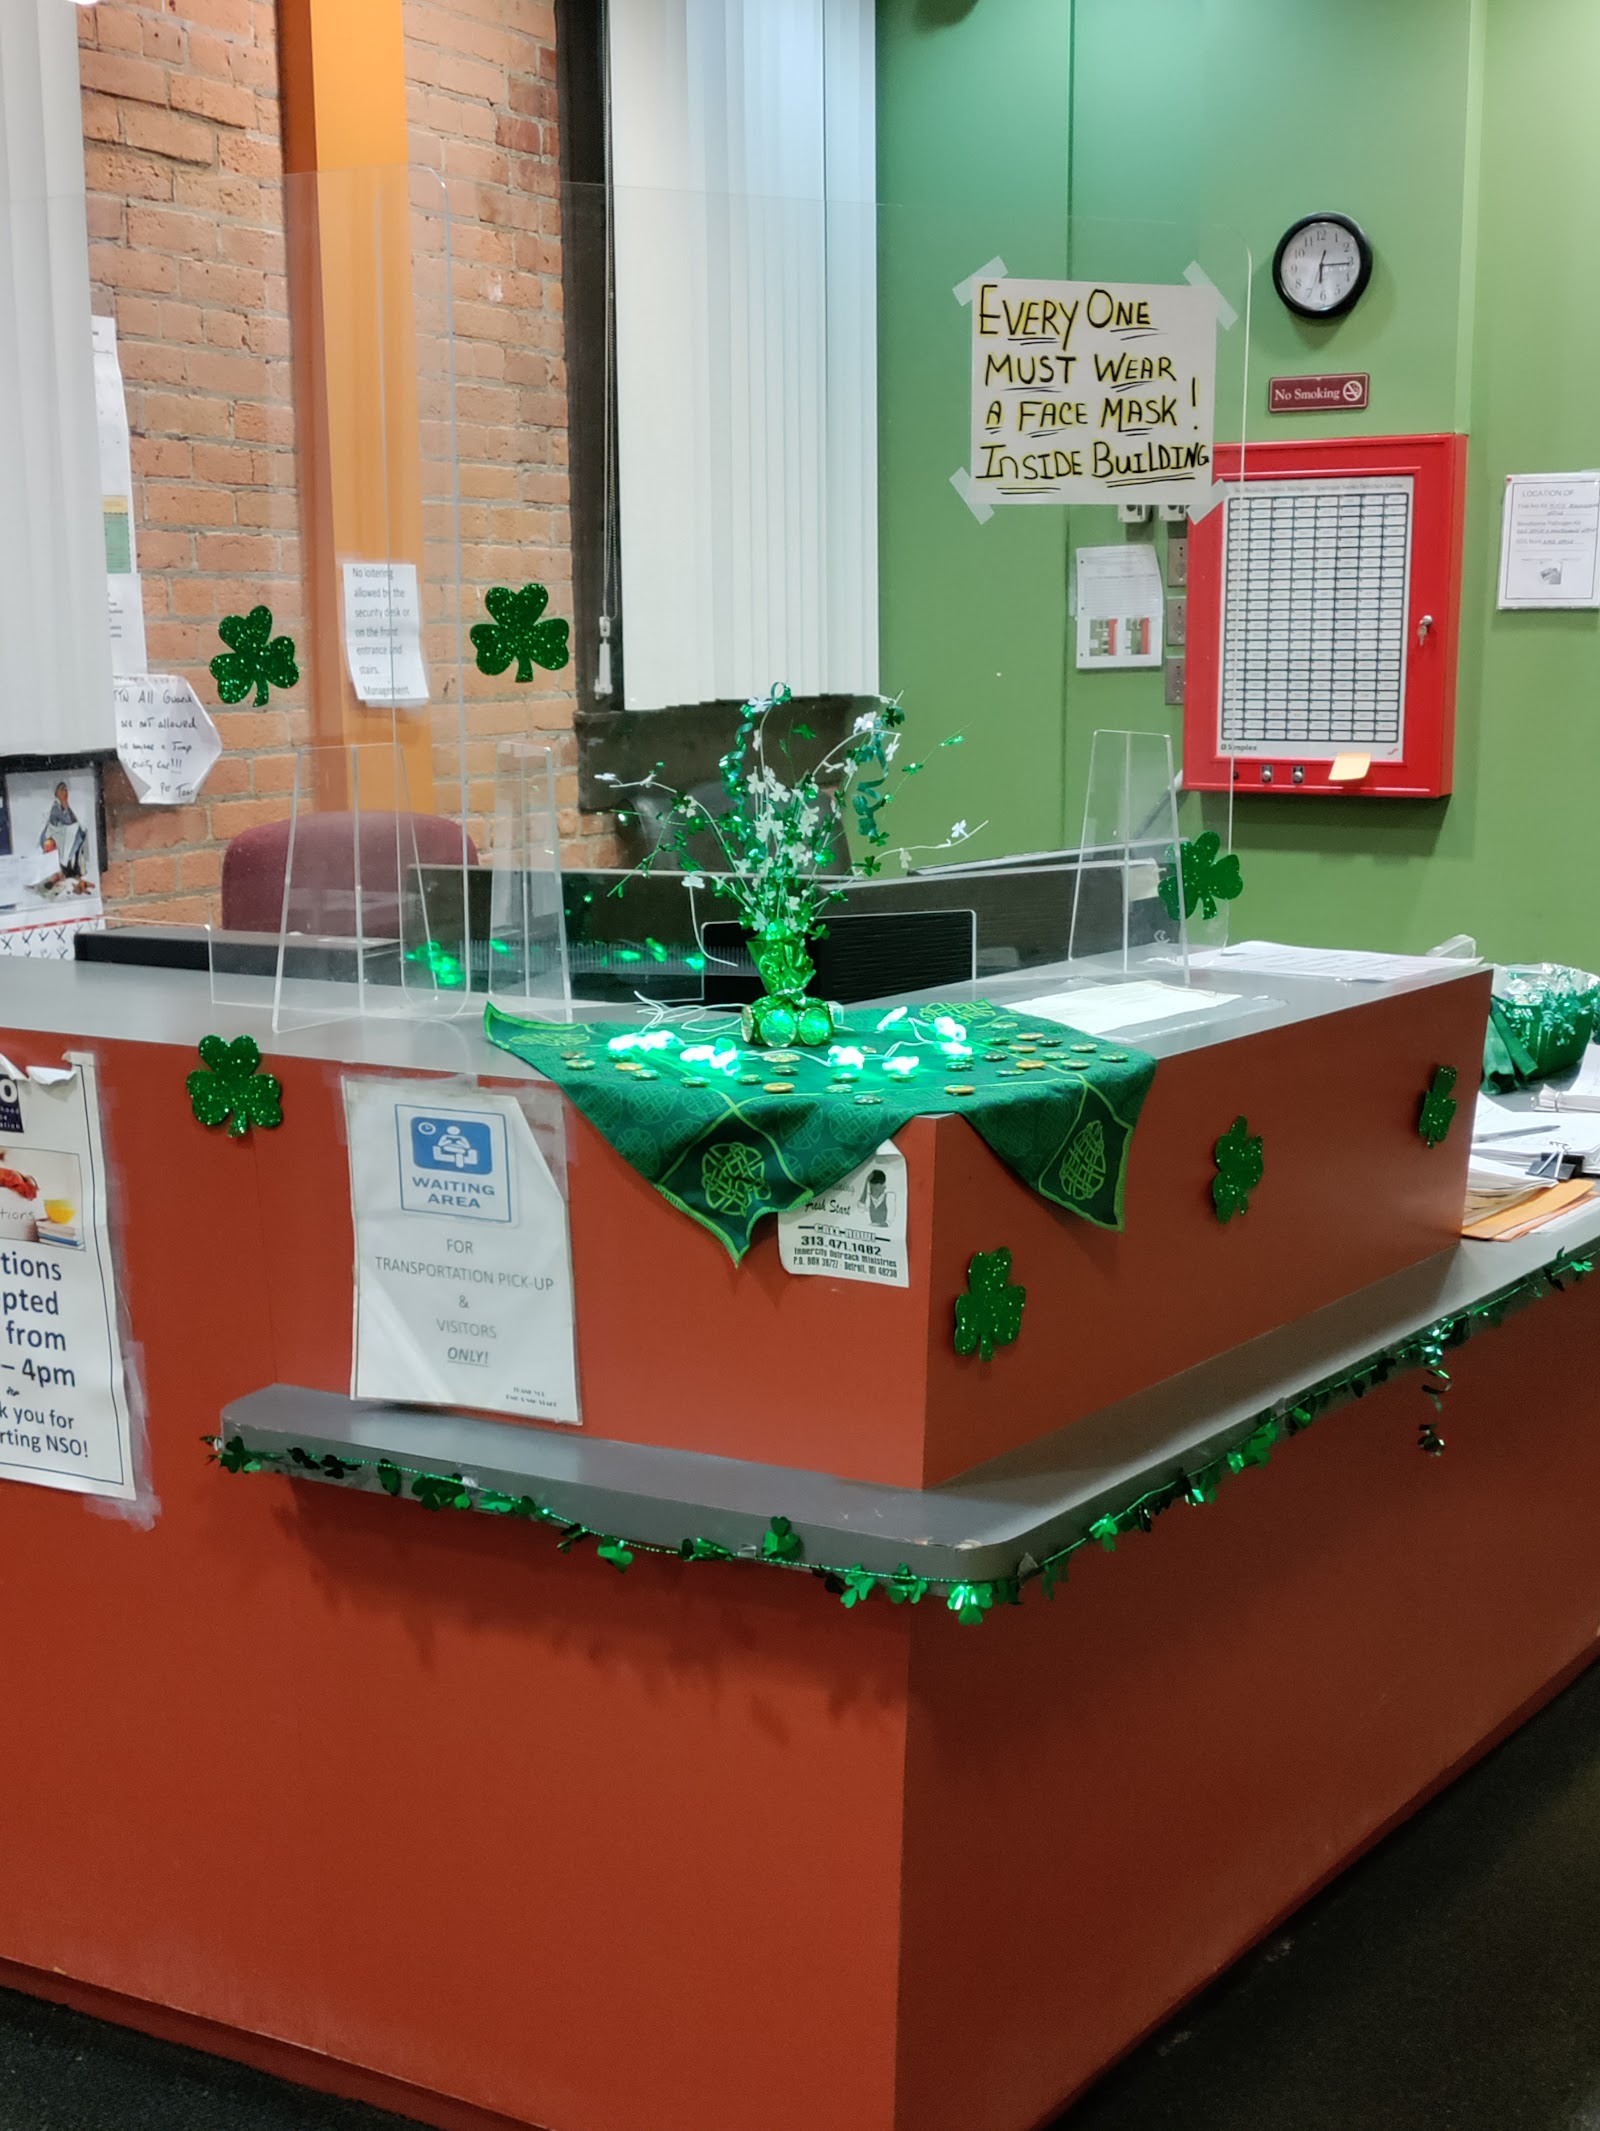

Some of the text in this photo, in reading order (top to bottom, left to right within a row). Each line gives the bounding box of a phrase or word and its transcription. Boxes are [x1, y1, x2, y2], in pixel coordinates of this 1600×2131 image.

[979, 284, 1151, 351] EVERY ONE
[985, 352, 1177, 387] MUST WEAR
[1274, 387, 1340, 401] No Smoking
[986, 400, 1002, 425] A
[1018, 401, 1089, 432] FACE
[1100, 395, 1178, 433] MASK
[1522, 489, 1561, 498] LOCATION
[352, 567, 363, 578] No
[354, 587, 381, 598] allowed
[392, 588, 406, 598] the
[355, 608, 383, 619] security
[402, 609, 411, 618] or
[355, 628, 365, 637] on
[366, 627, 379, 637] the
[356, 646, 388, 655] entrance
[138, 689, 154, 704] All
[158, 717, 198, 729] allowed
[1228, 744, 1258, 752] Smplex
[412, 1176, 496, 1197] WAITING
[427, 1193, 481, 1209] AREA
[829, 1200, 851, 1215] Start
[446, 1238, 474, 1255] FOR
[861, 1256, 897, 1267] Ministries
[375, 1255, 555, 1292] TRANSPORTATION PICK-UP
[458, 1294, 470, 1309] &
[5, 1320, 67, 1351] from
[436, 1318, 498, 1339] VISITORS
[447, 1346, 489, 1365] ONLY!
[22, 1358, 76, 1388] 4pm
[13, 1407, 45, 1425] you
[49, 1409, 75, 1430] for
[46, 1434, 89, 1458] NSO!
